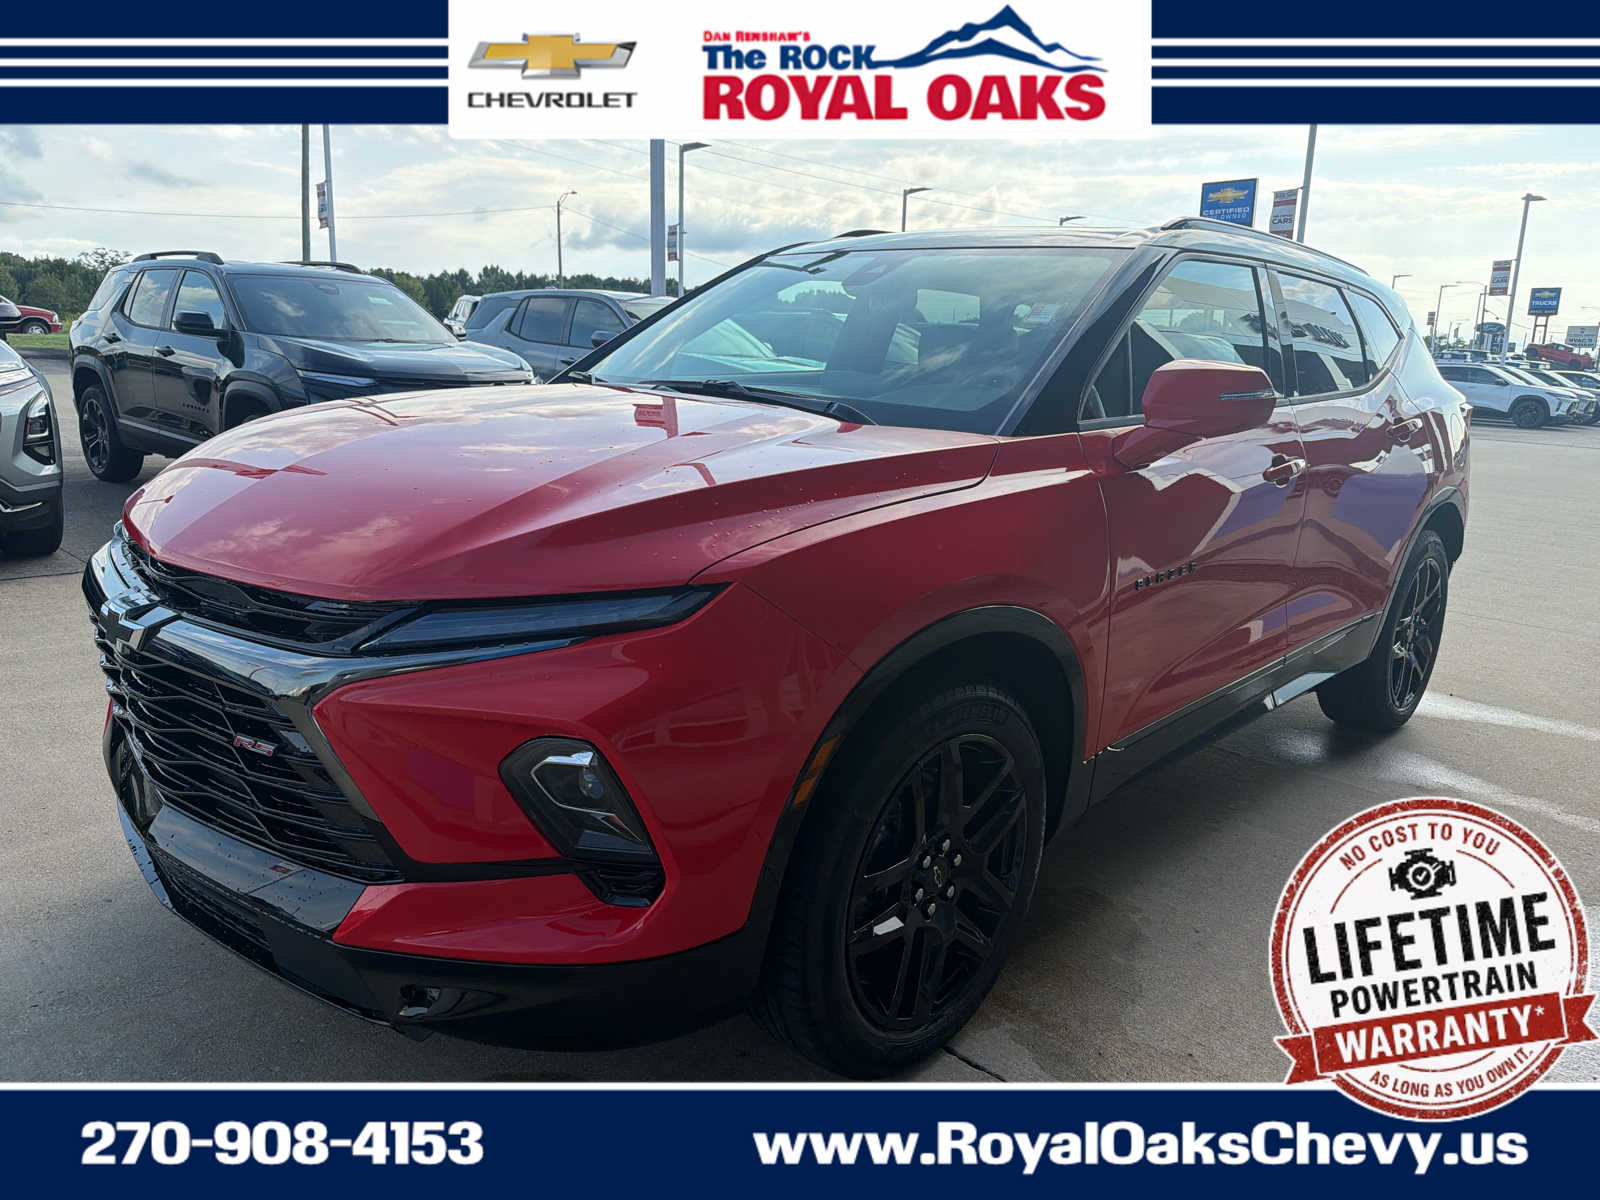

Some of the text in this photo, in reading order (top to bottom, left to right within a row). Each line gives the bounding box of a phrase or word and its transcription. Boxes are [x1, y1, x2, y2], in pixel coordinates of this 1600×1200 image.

[1202, 206, 1250, 216] CERTIFIED
[1135, 561, 1199, 592] BLAZER
[233, 735, 276, 757] RS
